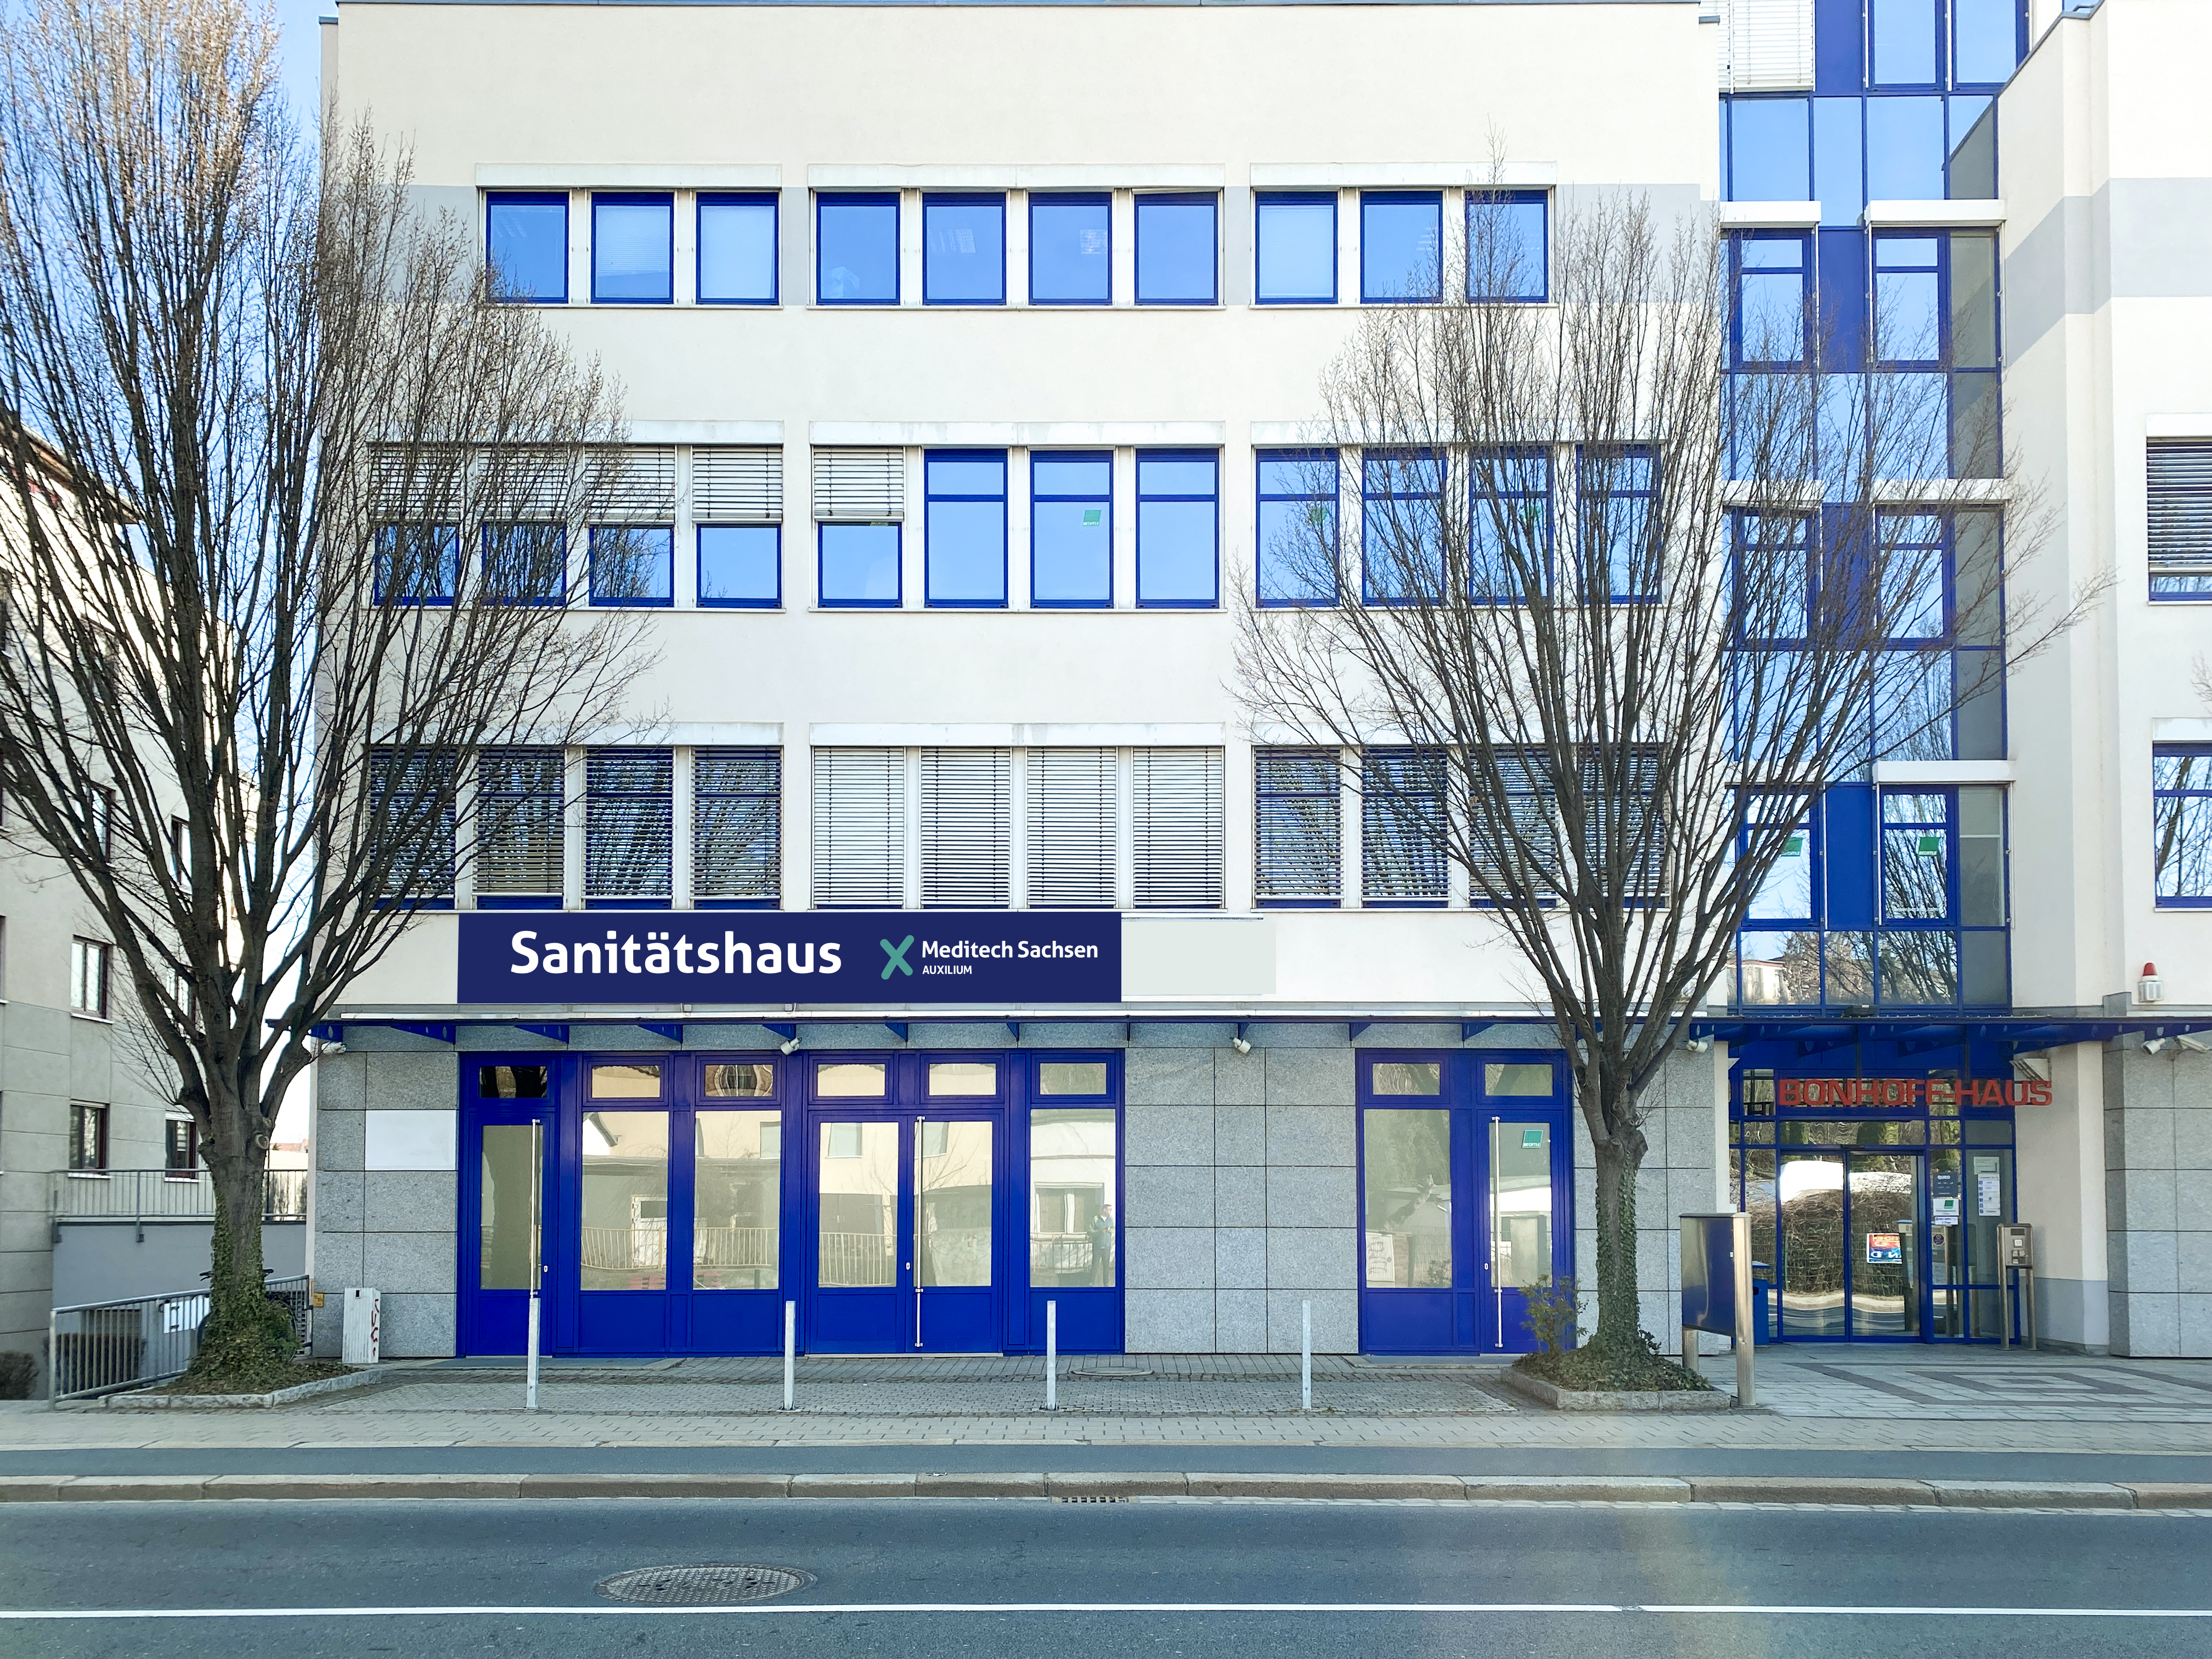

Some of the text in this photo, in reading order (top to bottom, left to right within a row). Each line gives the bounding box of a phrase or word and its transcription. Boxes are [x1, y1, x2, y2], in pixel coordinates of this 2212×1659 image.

[511, 930, 841, 973] Sanitätshaus
[922, 940, 1098, 958] Meditech Sachsen
[922, 965, 972, 974] AUXILIUM
[1779, 1079, 2052, 1106] BONHOFF-HAUS
